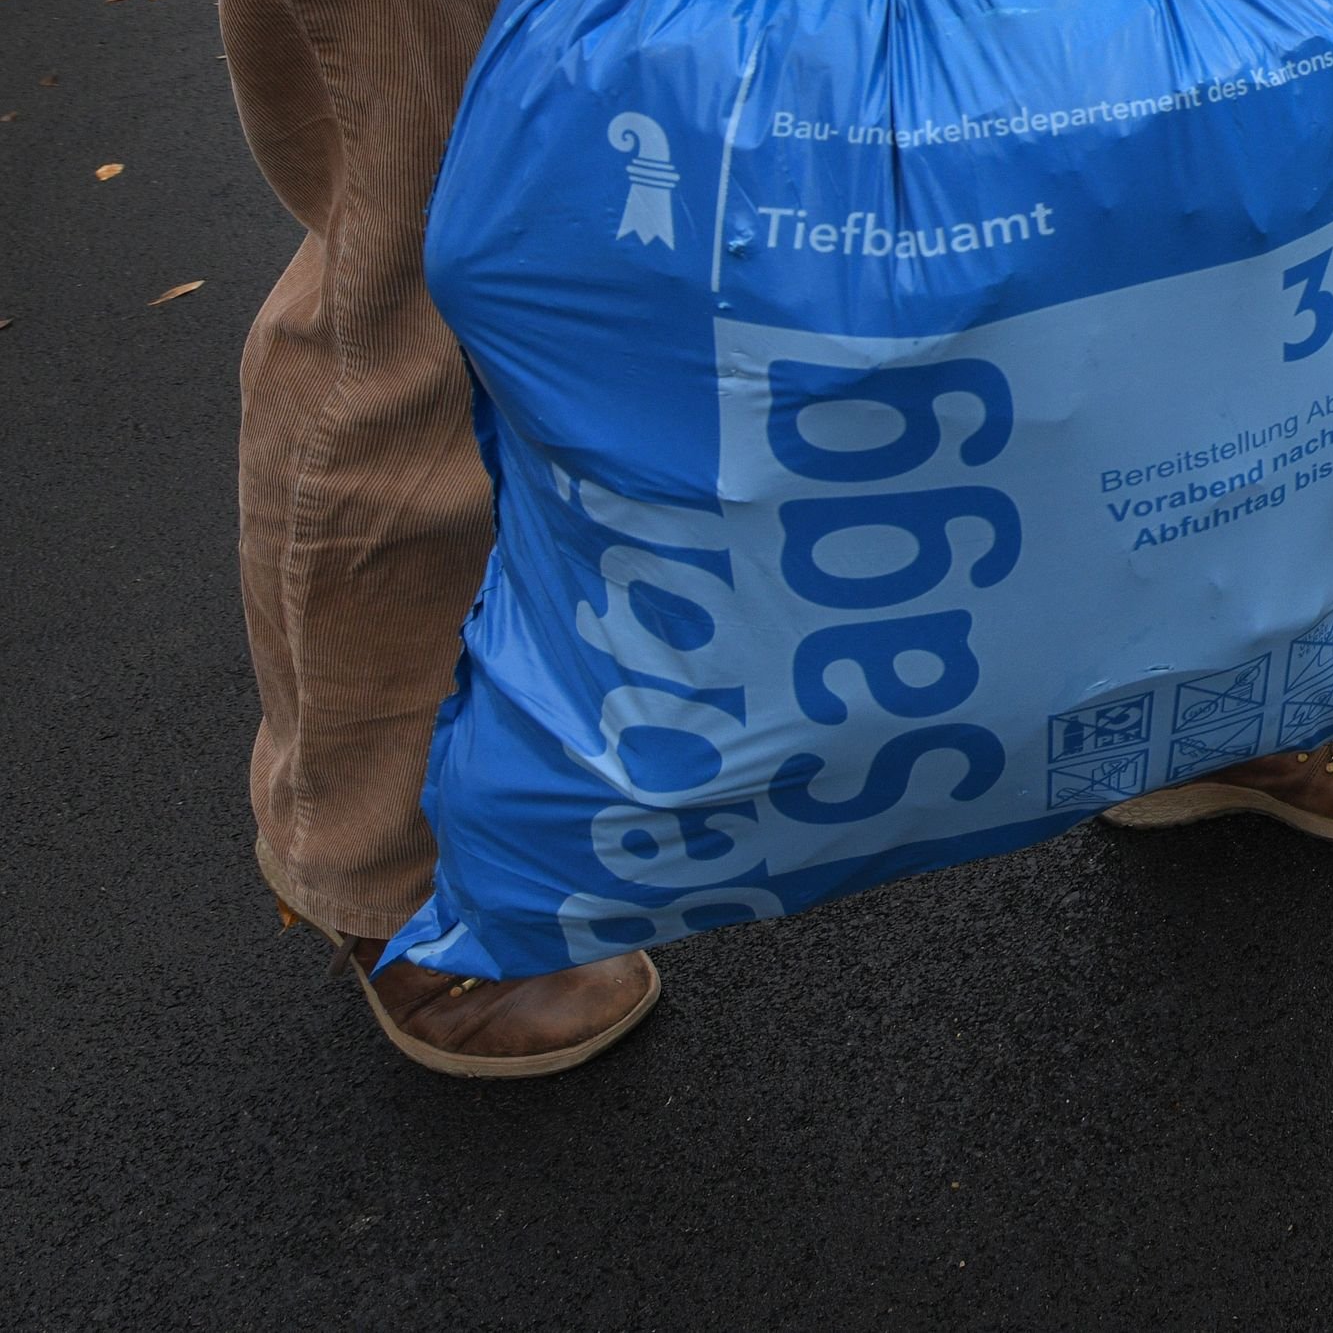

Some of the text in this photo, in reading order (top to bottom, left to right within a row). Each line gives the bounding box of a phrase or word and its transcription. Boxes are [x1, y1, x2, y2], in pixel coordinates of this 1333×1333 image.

[771, 111, 840, 143] Bau-
[1207, 76, 1249, 103] des
[757, 202, 1056, 259] Tiefbauamt
[1100, 414, 1299, 493] Bereitstellung
[1107, 459, 1264, 523] Vorabend
[1132, 485, 1287, 552] Abfuhrtag
[1295, 459, 1333, 493] bis
[766, 356, 1024, 826] Sagg
